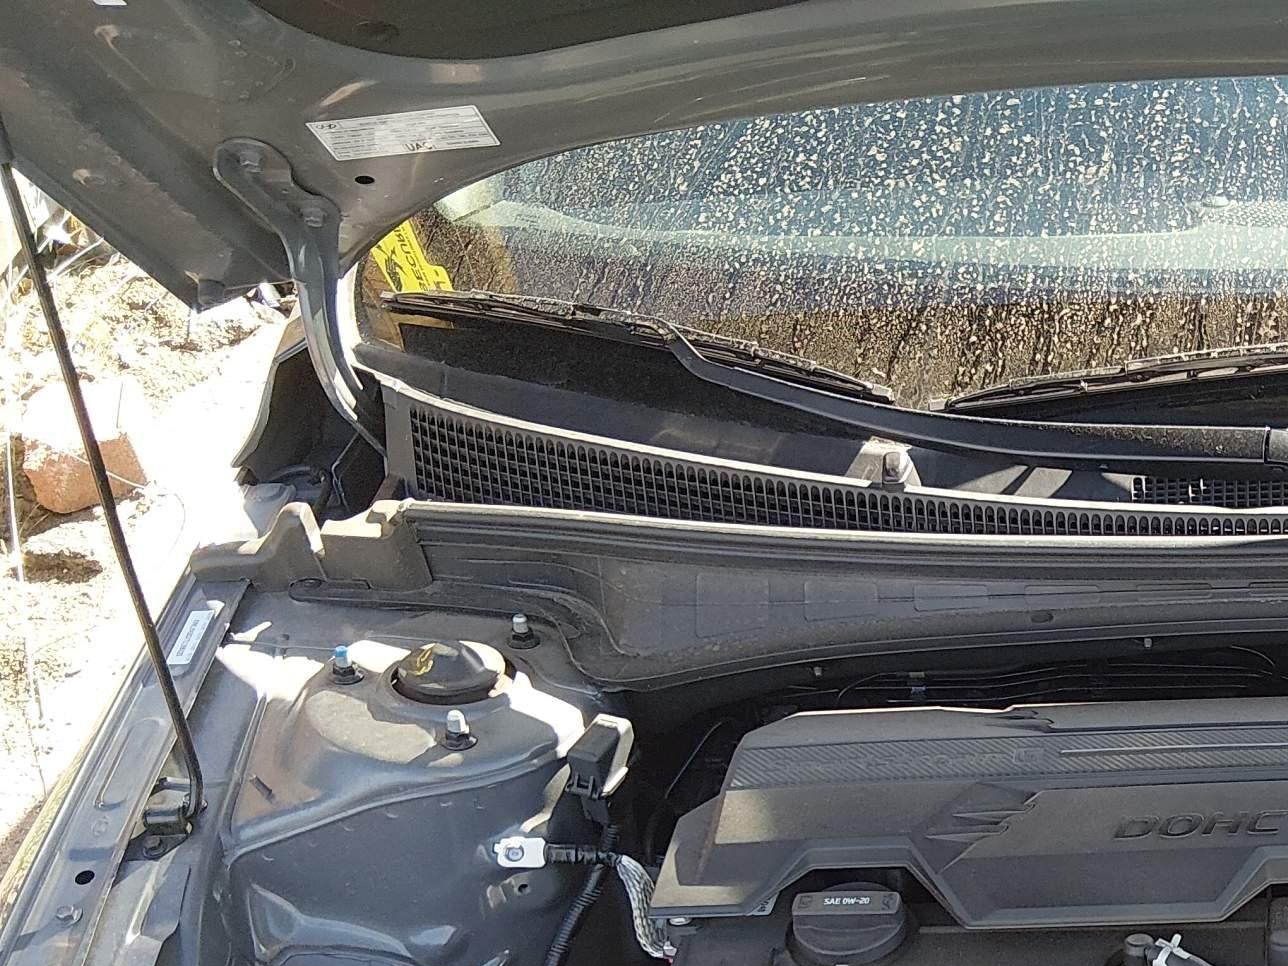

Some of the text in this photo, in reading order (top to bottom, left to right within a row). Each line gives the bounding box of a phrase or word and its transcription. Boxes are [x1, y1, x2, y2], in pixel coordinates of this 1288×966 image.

[1113, 809, 1288, 840] DOHC
[823, 896, 871, 906] SAE 0W-20
